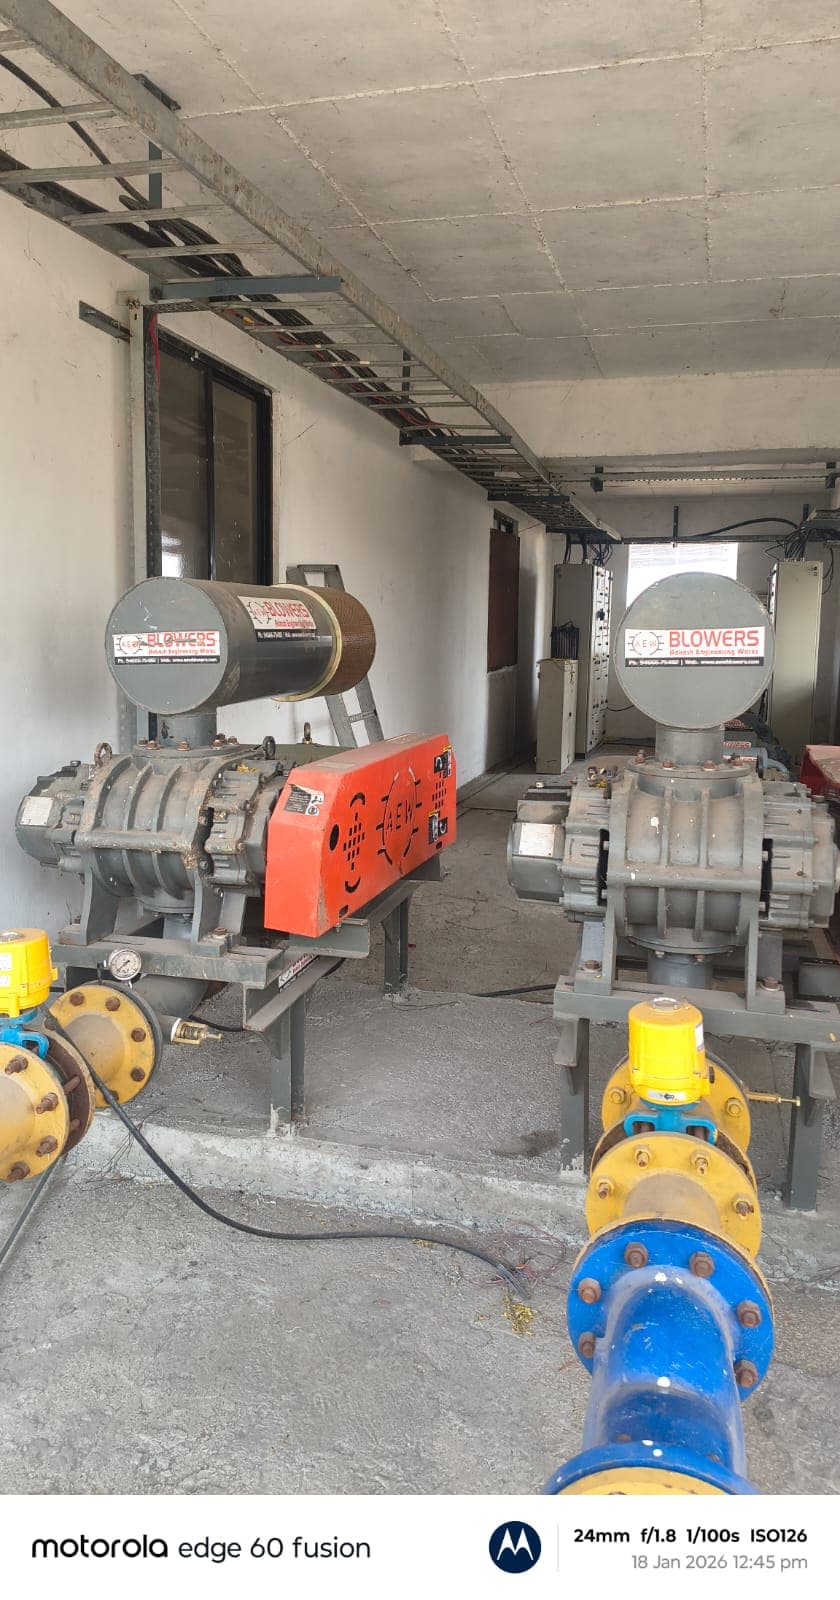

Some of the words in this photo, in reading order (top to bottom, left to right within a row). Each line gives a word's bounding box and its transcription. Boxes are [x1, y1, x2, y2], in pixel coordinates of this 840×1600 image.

[263, 601, 310, 617] BLOWERS
[147, 632, 216, 648] BLOWERS
[669, 630, 759, 648] BLOWERS
[386, 798, 414, 834] AEW
